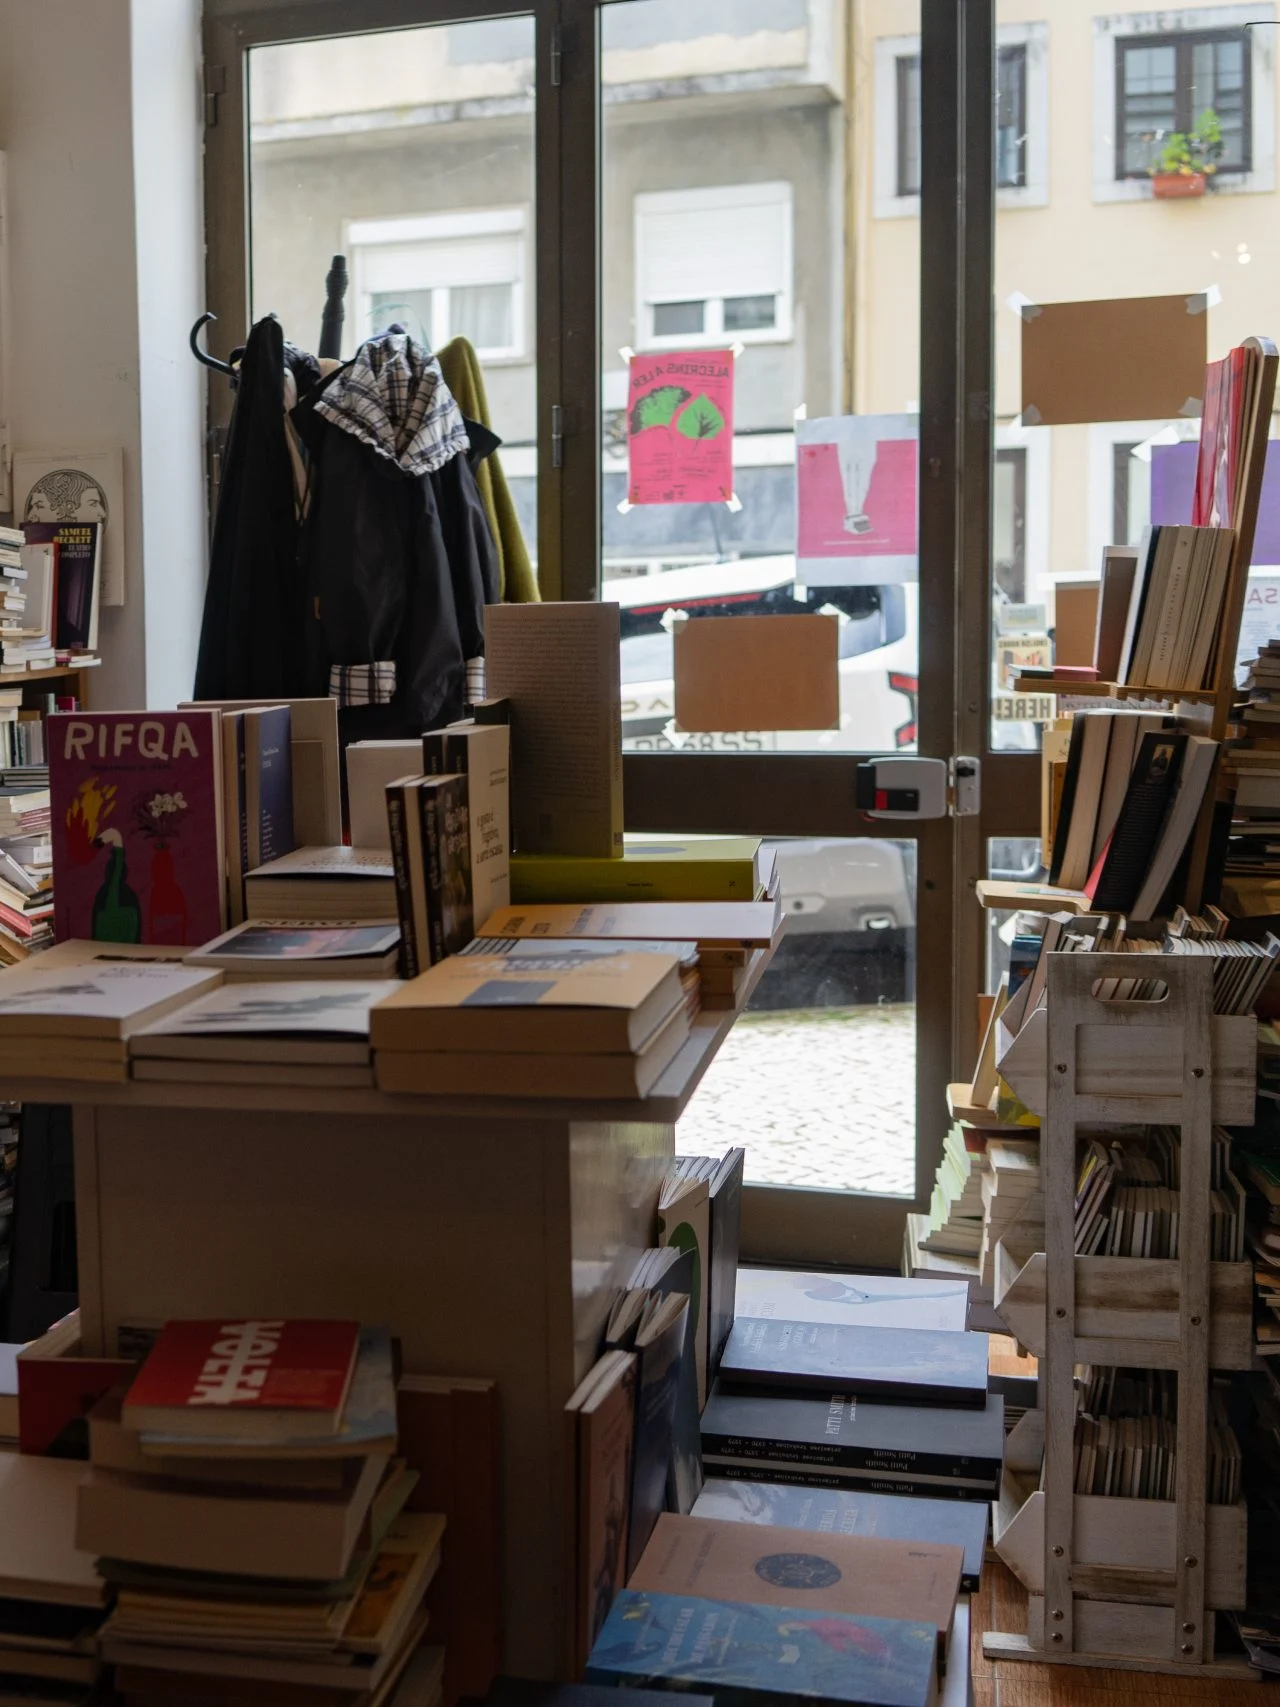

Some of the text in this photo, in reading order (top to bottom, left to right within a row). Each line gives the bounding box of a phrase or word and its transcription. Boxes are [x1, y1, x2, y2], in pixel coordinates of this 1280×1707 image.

[53, 528, 92, 544] SAMUEL BECKETT
[63, 721, 200, 761] RIFQA
[825, 1394, 845, 1435] PATTI SMITH
[873, 1448, 899, 1459] Smith
[899, 1449, 916, 1460] Patti
[865, 1458, 891, 1470] Smith
[891, 1459, 908, 1472] Patti
[871, 1480, 894, 1491] Smith
[895, 1482, 915, 1493] Patti
